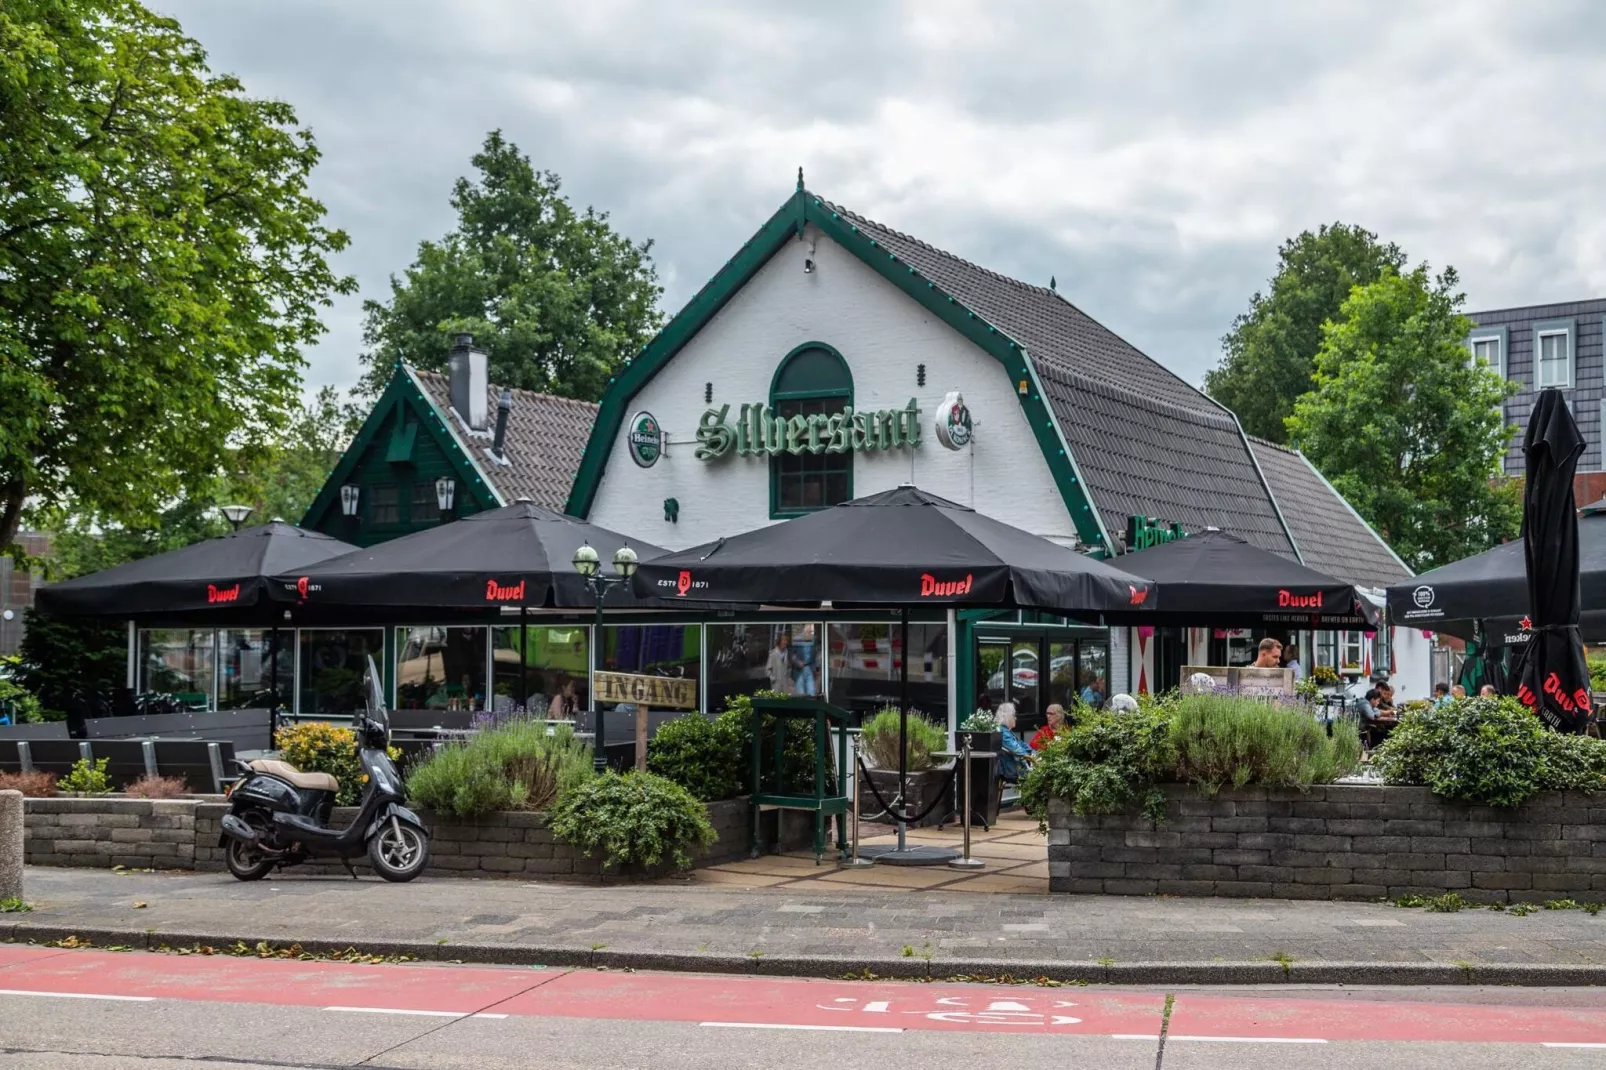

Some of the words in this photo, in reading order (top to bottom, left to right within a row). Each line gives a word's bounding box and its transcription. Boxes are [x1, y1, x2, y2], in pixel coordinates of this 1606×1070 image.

[695, 398, 923, 461] Silversant
[1128, 515, 1191, 552] Heinek
[207, 583, 240, 603] Duvel
[485, 579, 526, 601] Duvel
[692, 581, 709, 589] 1871
[920, 573, 973, 597] Duvel
[1278, 590, 1322, 608] Duvel
[605, 675, 688, 704] INGANG
[1543, 672, 1576, 713] Duv
